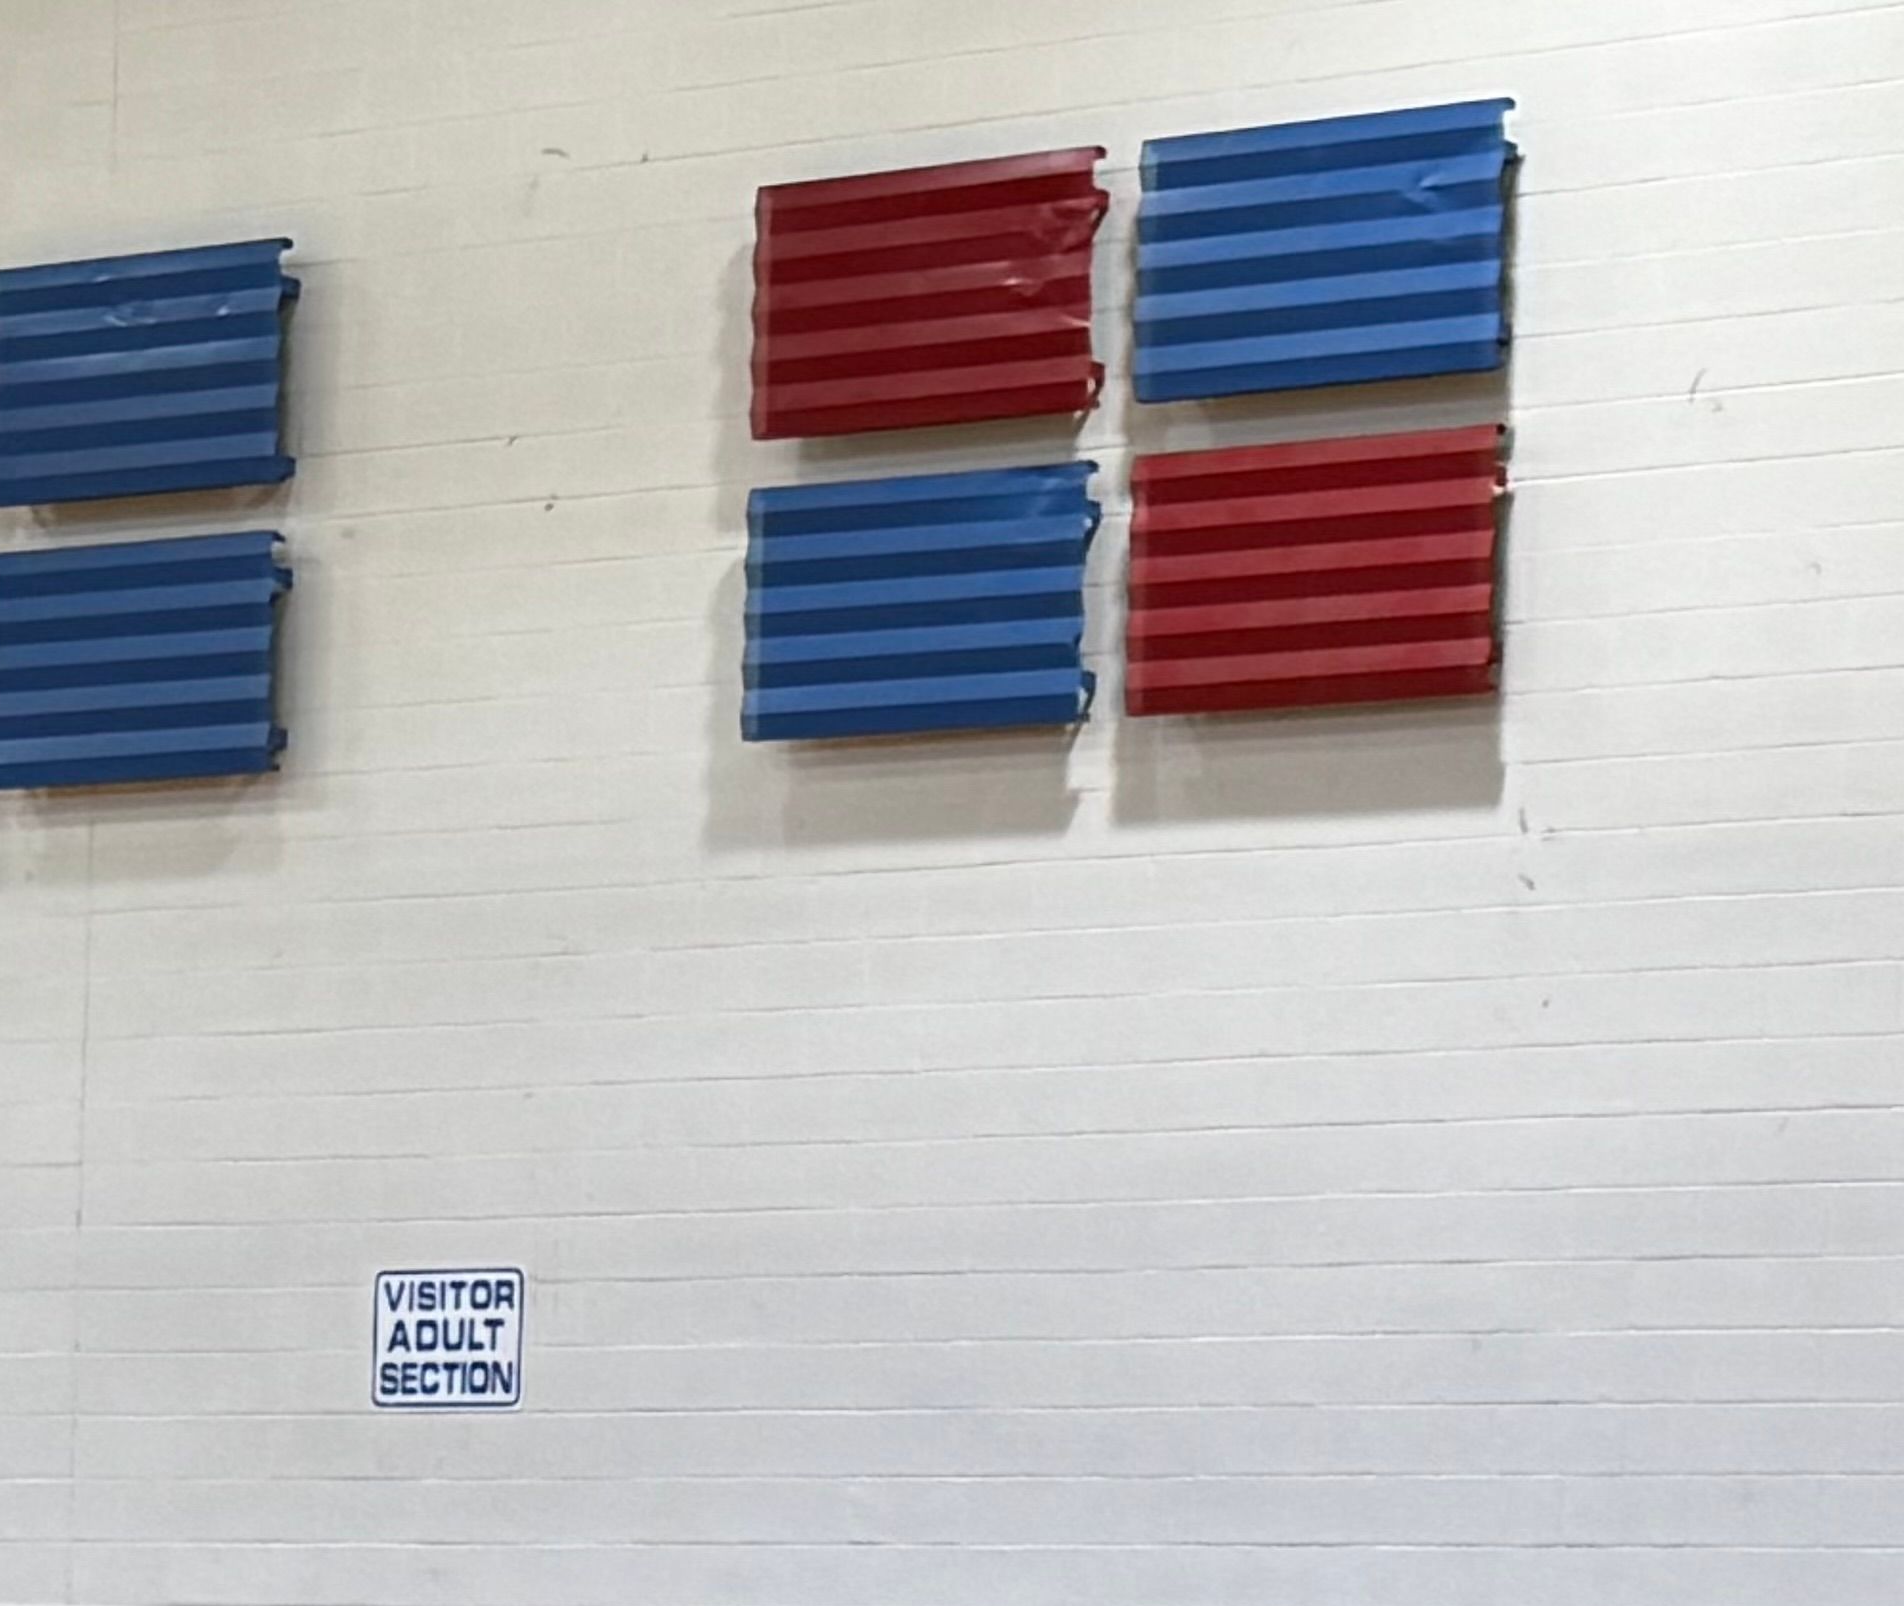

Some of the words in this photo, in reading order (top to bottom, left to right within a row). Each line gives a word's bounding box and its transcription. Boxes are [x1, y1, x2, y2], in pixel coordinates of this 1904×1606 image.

[384, 1279, 515, 1312] VISITOR
[387, 1318, 505, 1353] ADULT
[380, 1361, 513, 1396] SECTION
